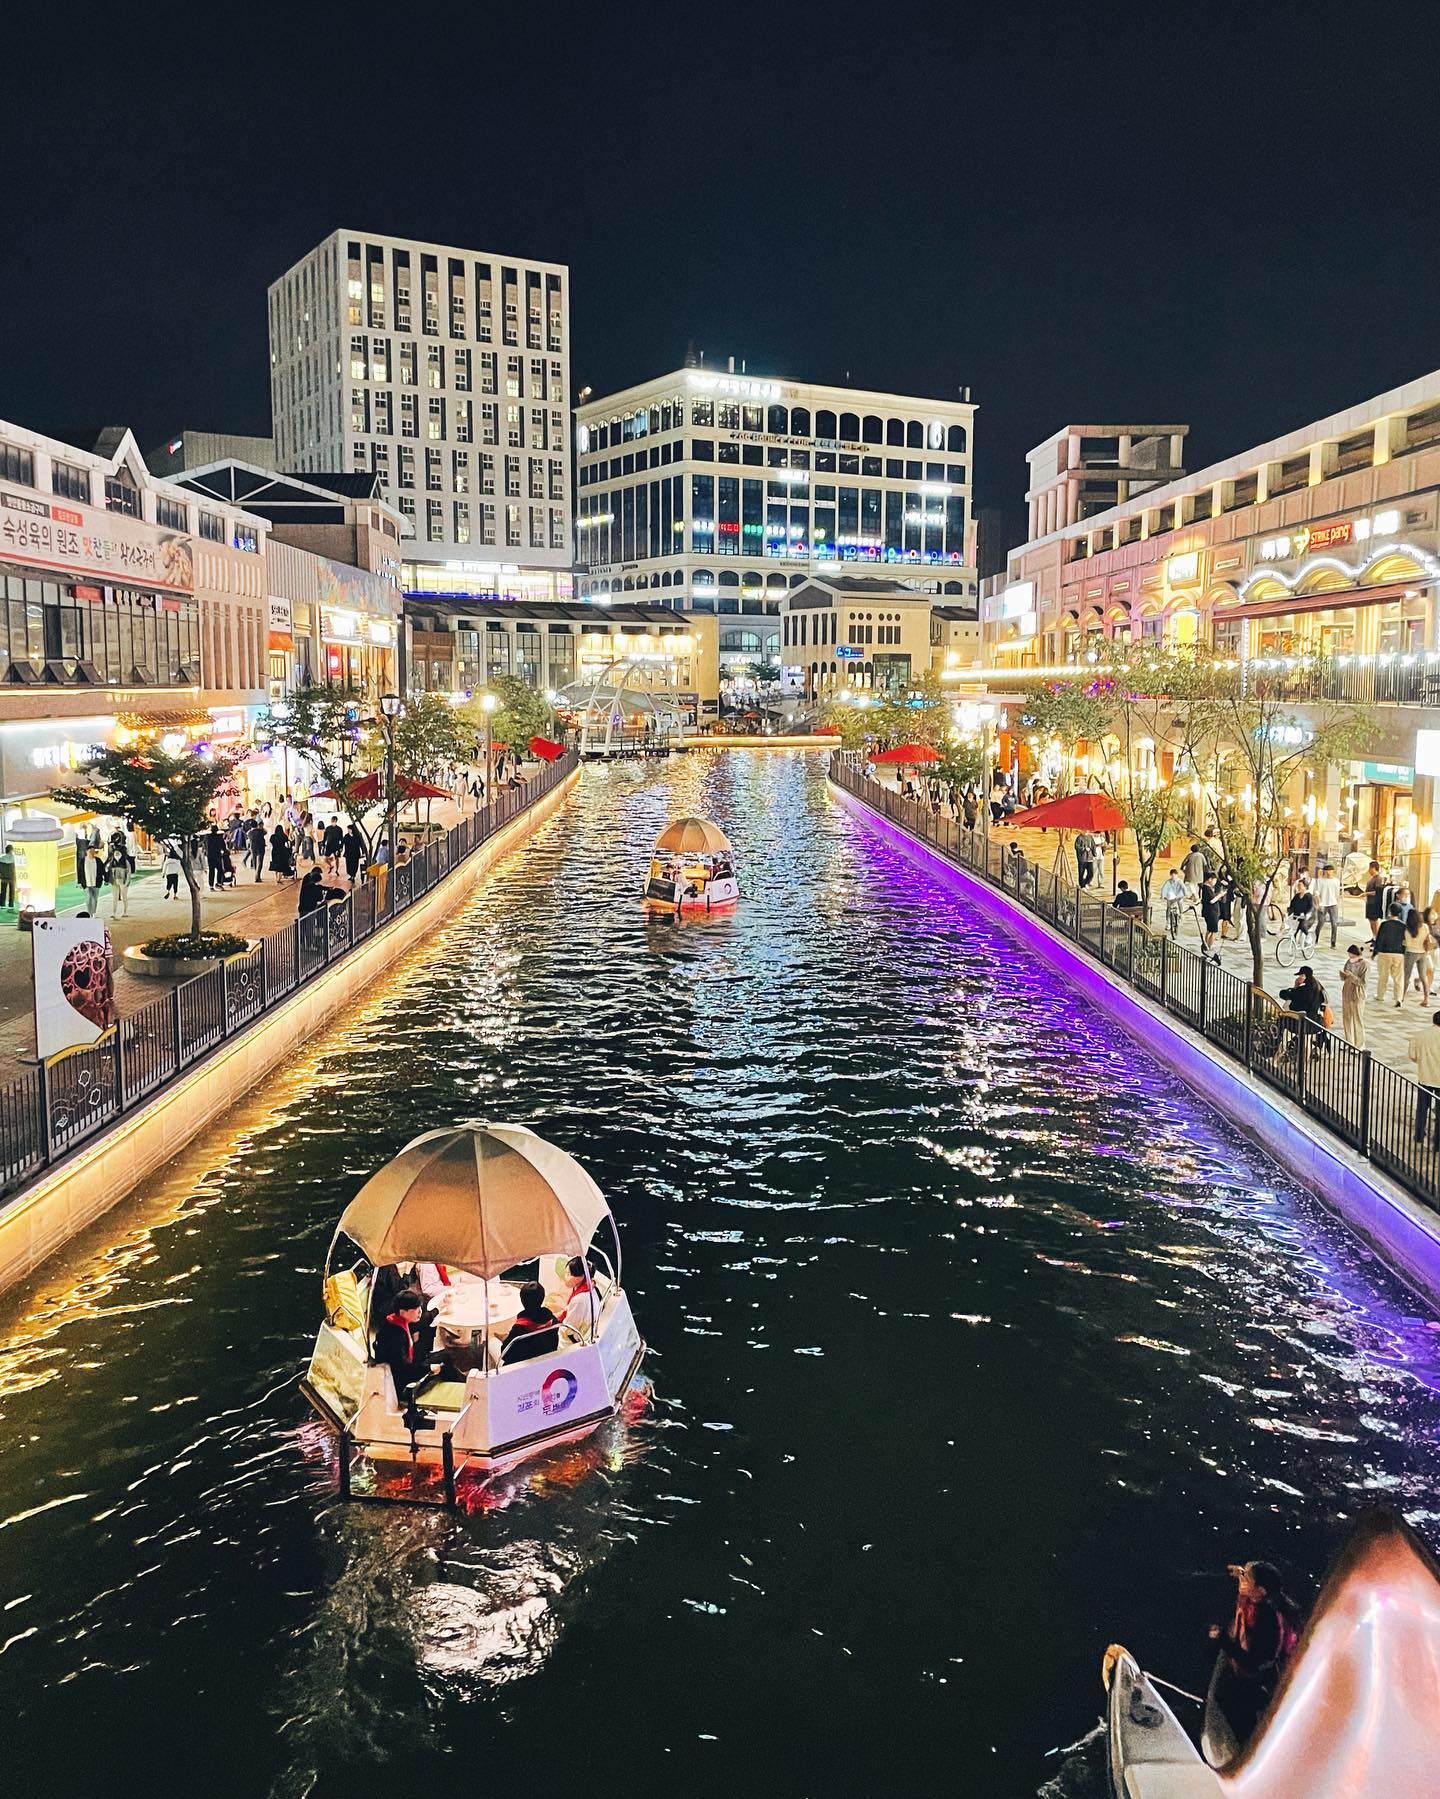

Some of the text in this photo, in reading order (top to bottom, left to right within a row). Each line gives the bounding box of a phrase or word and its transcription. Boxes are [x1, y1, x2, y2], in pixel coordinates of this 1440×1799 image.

[3, 516, 53, 552] 숙성육의
[57, 529, 79, 554] 원조
[1330, 524, 1349, 544] pang
